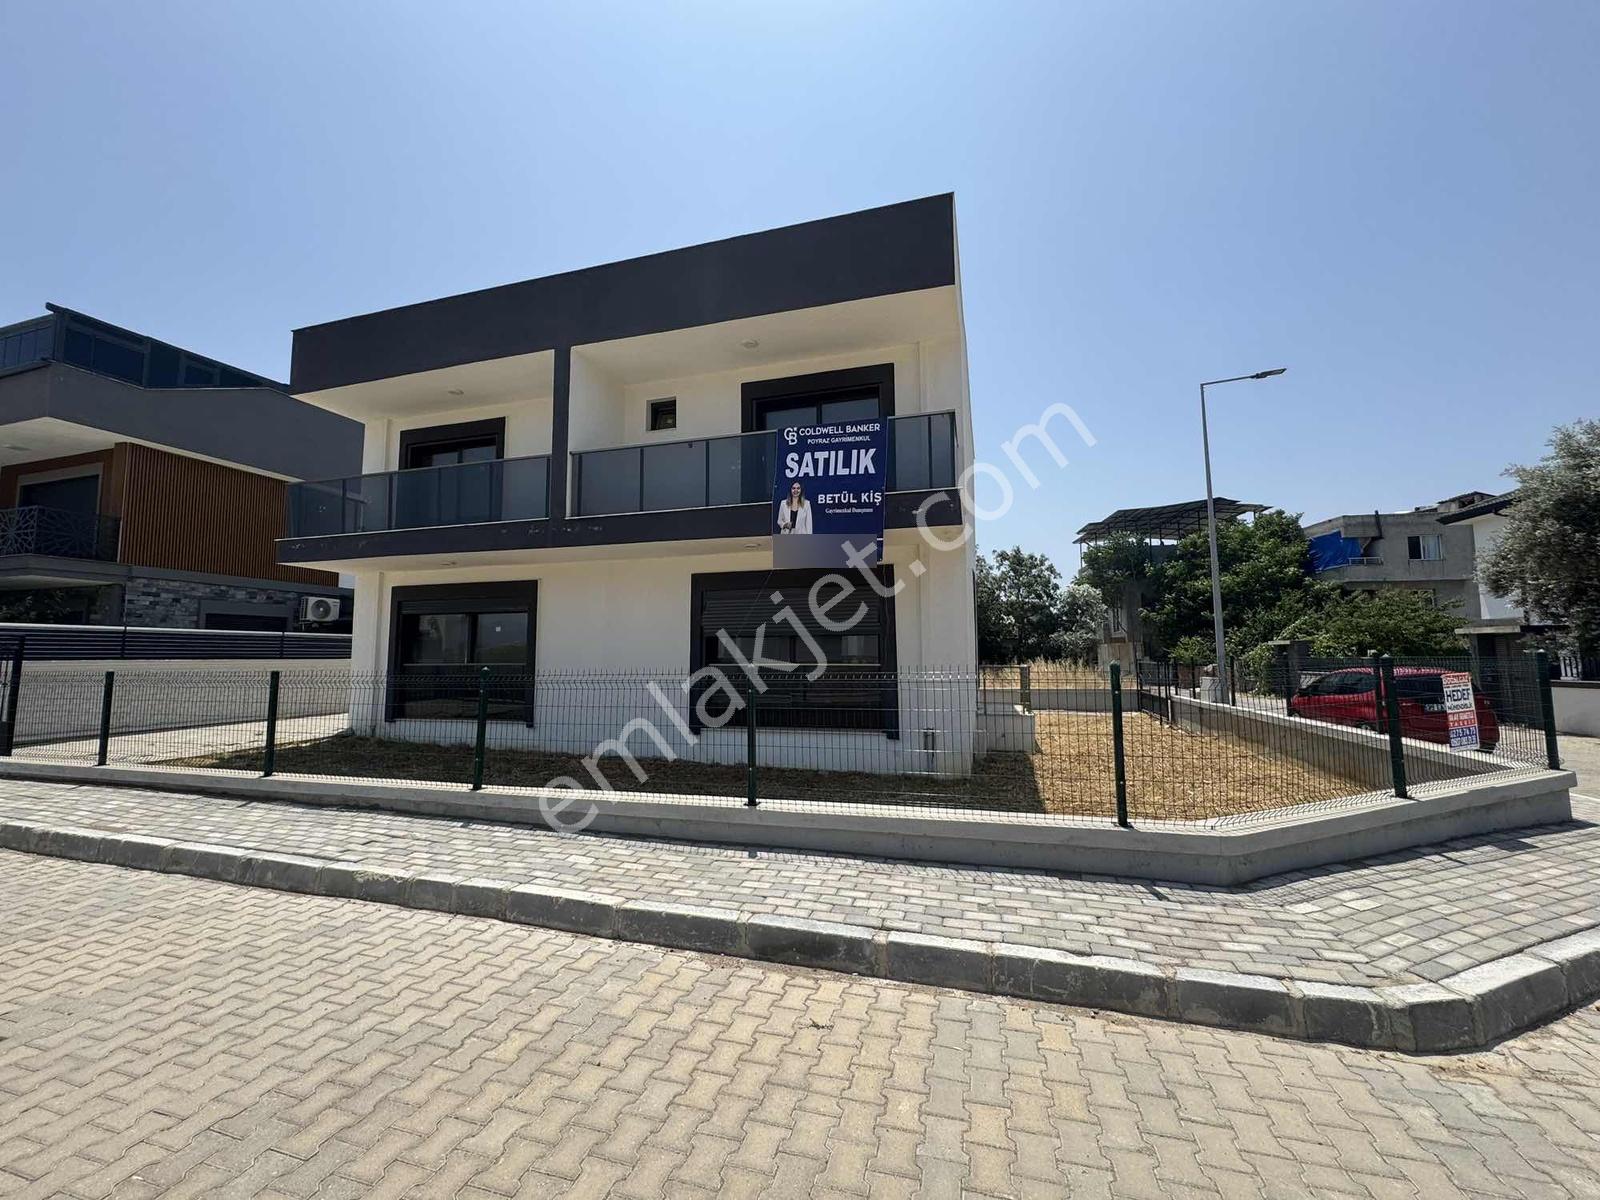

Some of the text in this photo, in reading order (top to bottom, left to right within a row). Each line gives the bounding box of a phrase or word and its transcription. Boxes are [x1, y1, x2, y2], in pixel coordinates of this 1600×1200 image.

[799, 423, 880, 436] COLDWELL BANKER
[807, 437, 830, 445] POYRAZ
[785, 448, 877, 478] SATILIK
[818, 490, 882, 506] BETÜL KİŞ
[1446, 689, 1470, 702] HEDEF
